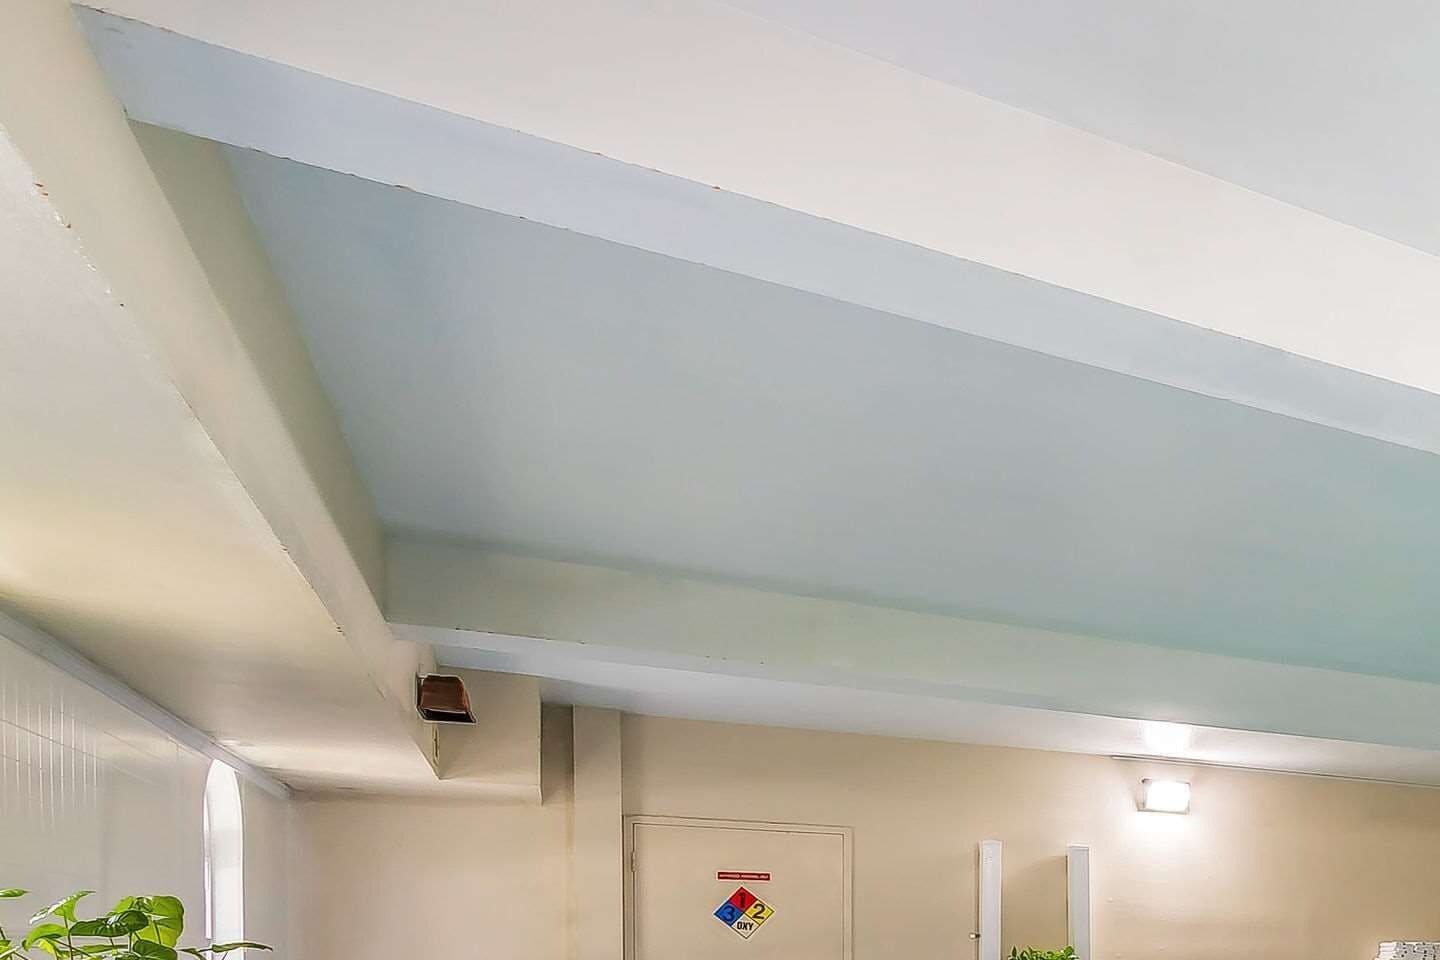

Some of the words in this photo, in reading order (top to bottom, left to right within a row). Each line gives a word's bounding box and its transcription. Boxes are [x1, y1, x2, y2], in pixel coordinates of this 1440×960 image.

[738, 892, 746, 909] 1
[723, 905, 736, 921] 3
[752, 903, 766, 920] 2
[736, 921, 754, 931] OXY
